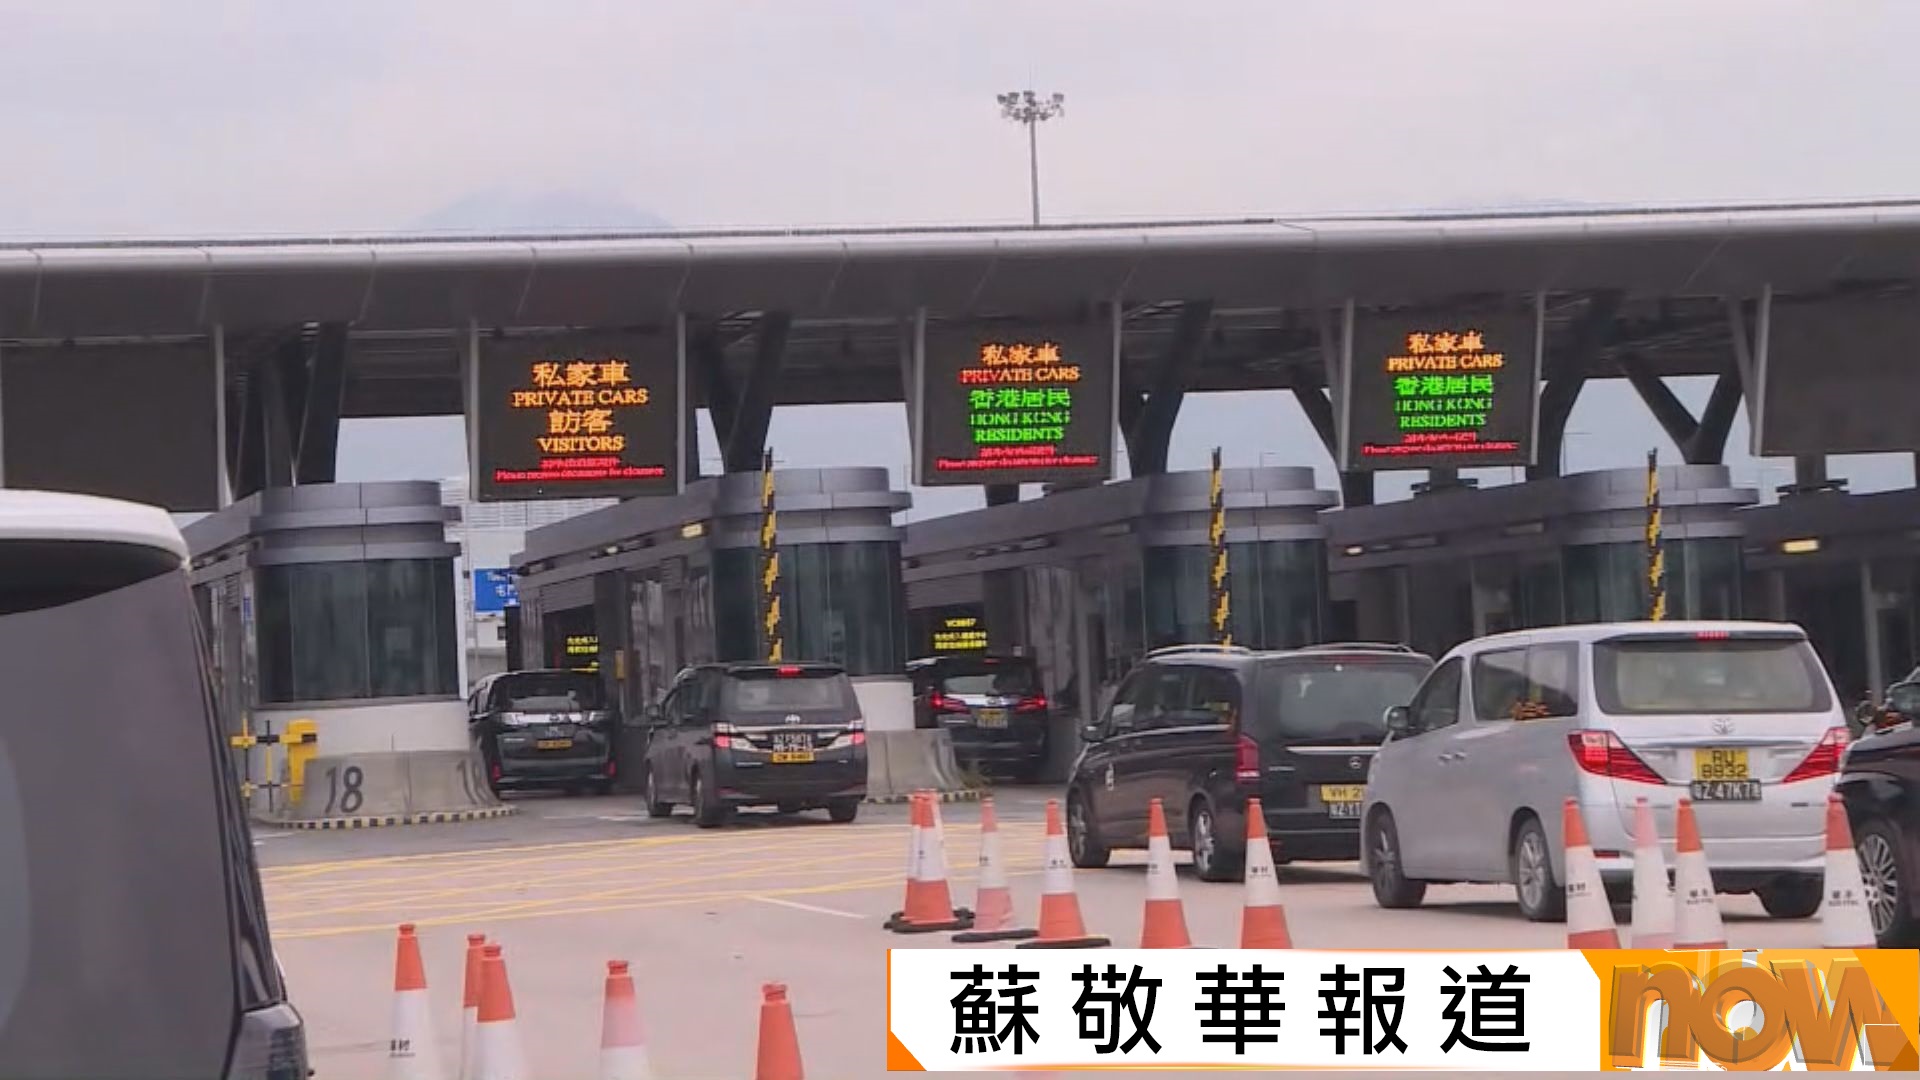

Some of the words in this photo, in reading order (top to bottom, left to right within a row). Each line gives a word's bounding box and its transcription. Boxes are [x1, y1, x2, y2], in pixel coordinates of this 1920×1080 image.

[1408, 330, 1484, 353] 私家車
[982, 342, 1060, 366] 私家車
[1387, 355, 1457, 371] PRIVATE
[1460, 353, 1504, 369] CARS
[533, 360, 631, 387] 私家車
[960, 367, 1033, 384] PRIVATE
[1035, 366, 1081, 382] CARS
[1394, 374, 1493, 396] 香港居民
[512, 389, 595, 407] PRIVATE
[598, 387, 650, 405] CARS
[969, 388, 1071, 409] 香港居民
[1395, 398, 1442, 411] HONG
[1446, 397, 1492, 410] KONG
[548, 408, 613, 434] 訪客
[970, 412, 1018, 426] HONG
[1022, 410, 1070, 424] KONG
[1399, 413, 1486, 429] RESIDENTS
[536, 435, 626, 452] VISITORS
[974, 427, 1064, 443] RESIDENTS
[324, 766, 363, 813] 18
